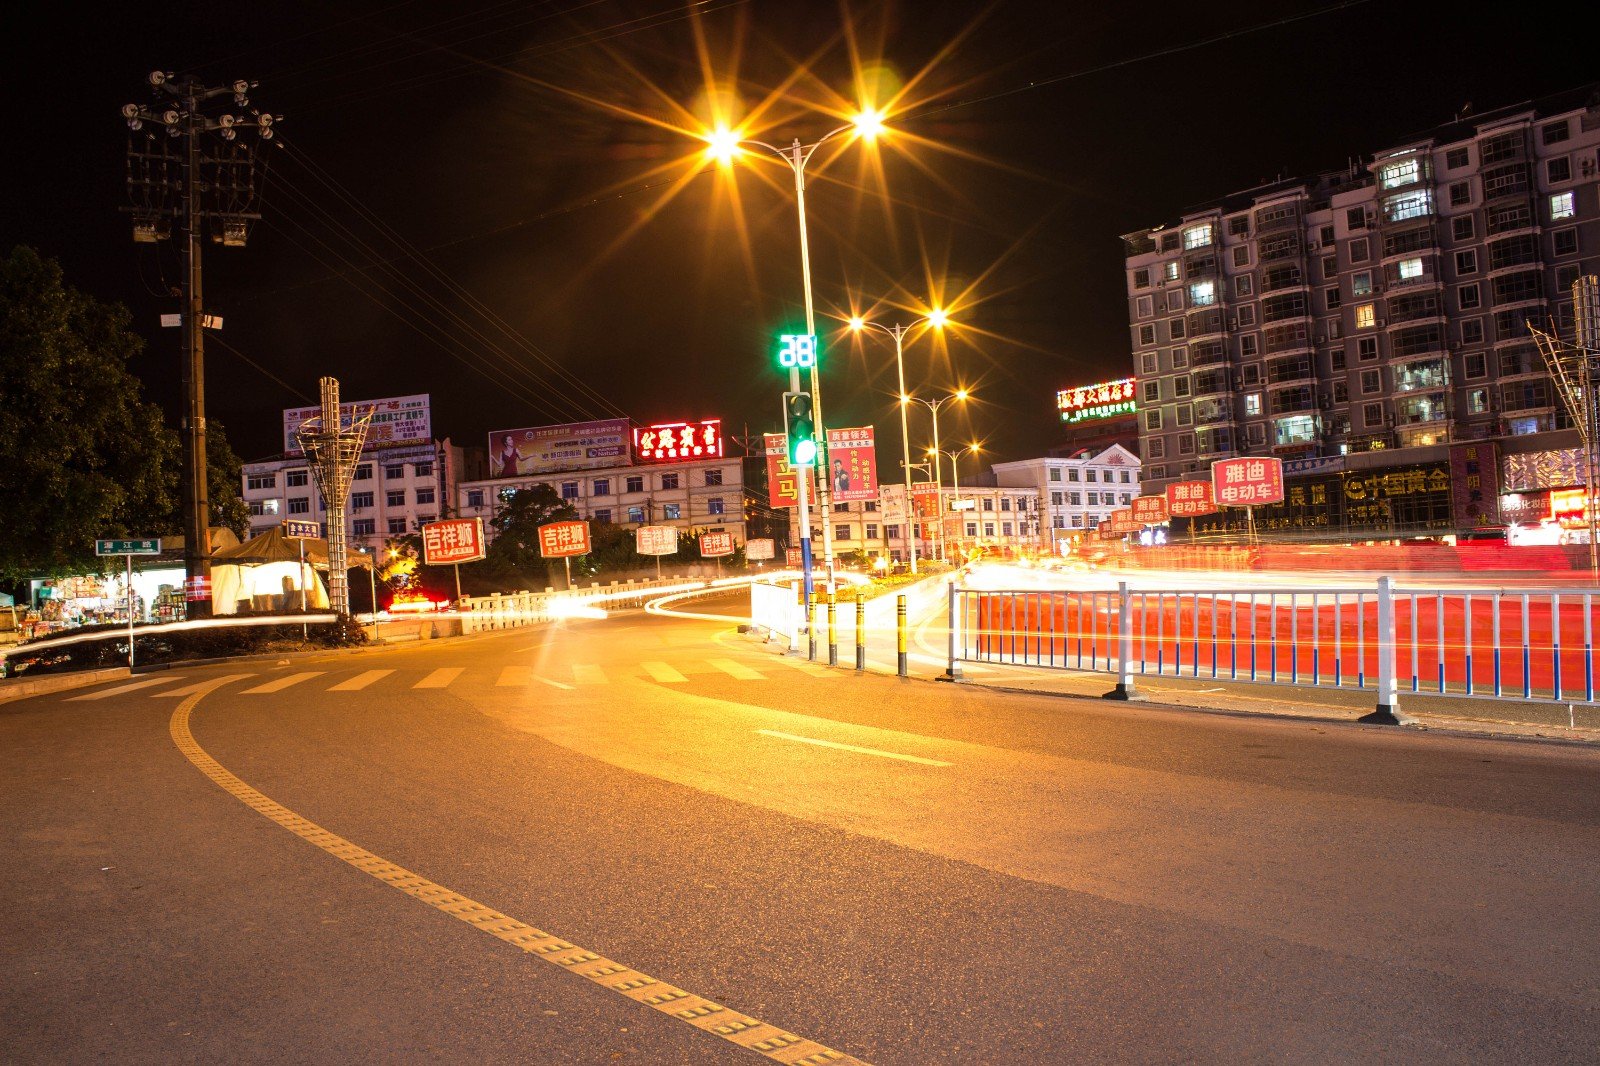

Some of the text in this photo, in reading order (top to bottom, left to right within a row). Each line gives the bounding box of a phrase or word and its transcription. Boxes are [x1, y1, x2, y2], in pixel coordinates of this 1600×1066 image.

[832, 429, 869, 441] 质量领先
[1226, 461, 1265, 483] 雅迪
[1364, 467, 1449, 497] 中国黄金
[1174, 484, 1204, 499] 雅迪
[1221, 483, 1272, 501] 电动车
[1137, 499, 1160, 511] 雅迪
[1171, 501, 1209, 514] 电动车
[1134, 511, 1164, 522] 电动车
[426, 522, 473, 550] 吉祥狮
[544, 524, 585, 547] 吉祥狮
[702, 531, 730, 549] 吉祥狮
